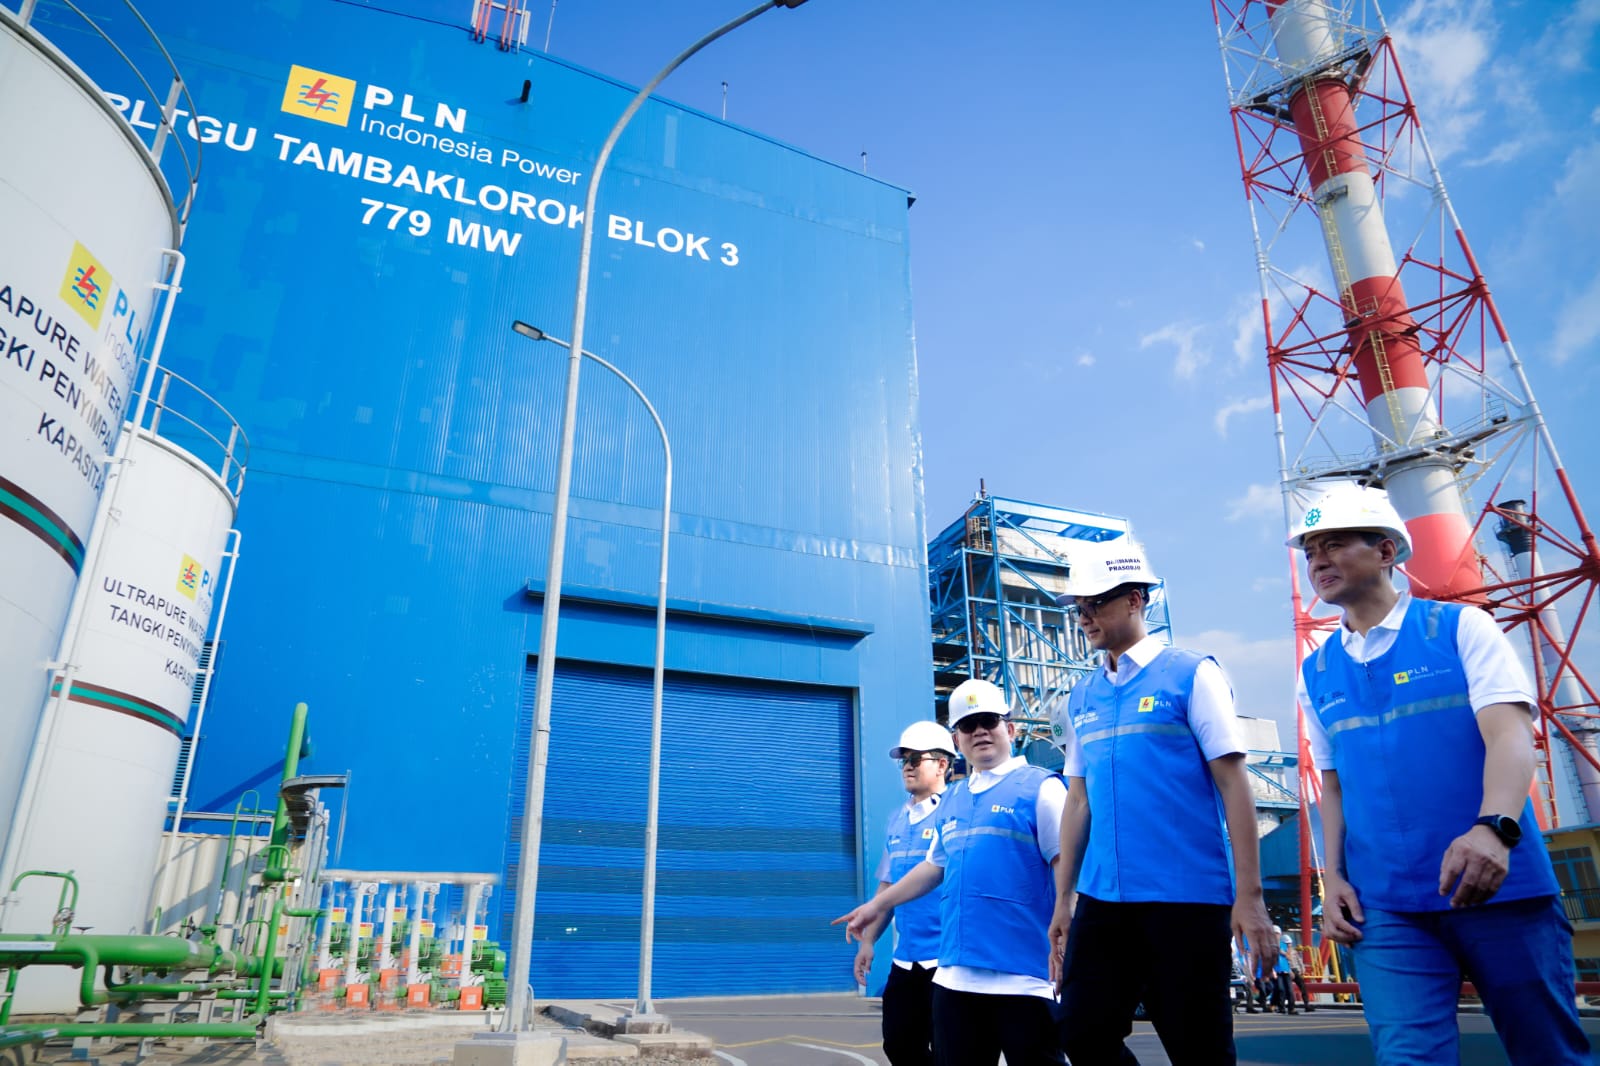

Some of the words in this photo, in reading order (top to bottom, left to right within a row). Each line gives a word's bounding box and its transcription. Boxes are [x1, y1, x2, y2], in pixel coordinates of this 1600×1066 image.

[362, 84, 467, 134] PLN
[360, 113, 493, 165] Indonesia
[501, 149, 582, 186] Power
[359, 197, 432, 237] 779
[446, 217, 523, 257] MW
[607, 213, 712, 261] BLOK
[720, 242, 740, 267] 3
[39, 359, 114, 454] PENYIMPA
[84, 351, 122, 421] WATER
[102, 576, 188, 626] ULTRAPURE
[109, 604, 167, 640] TANGKI
[1407, 664, 1429, 676] PLN
